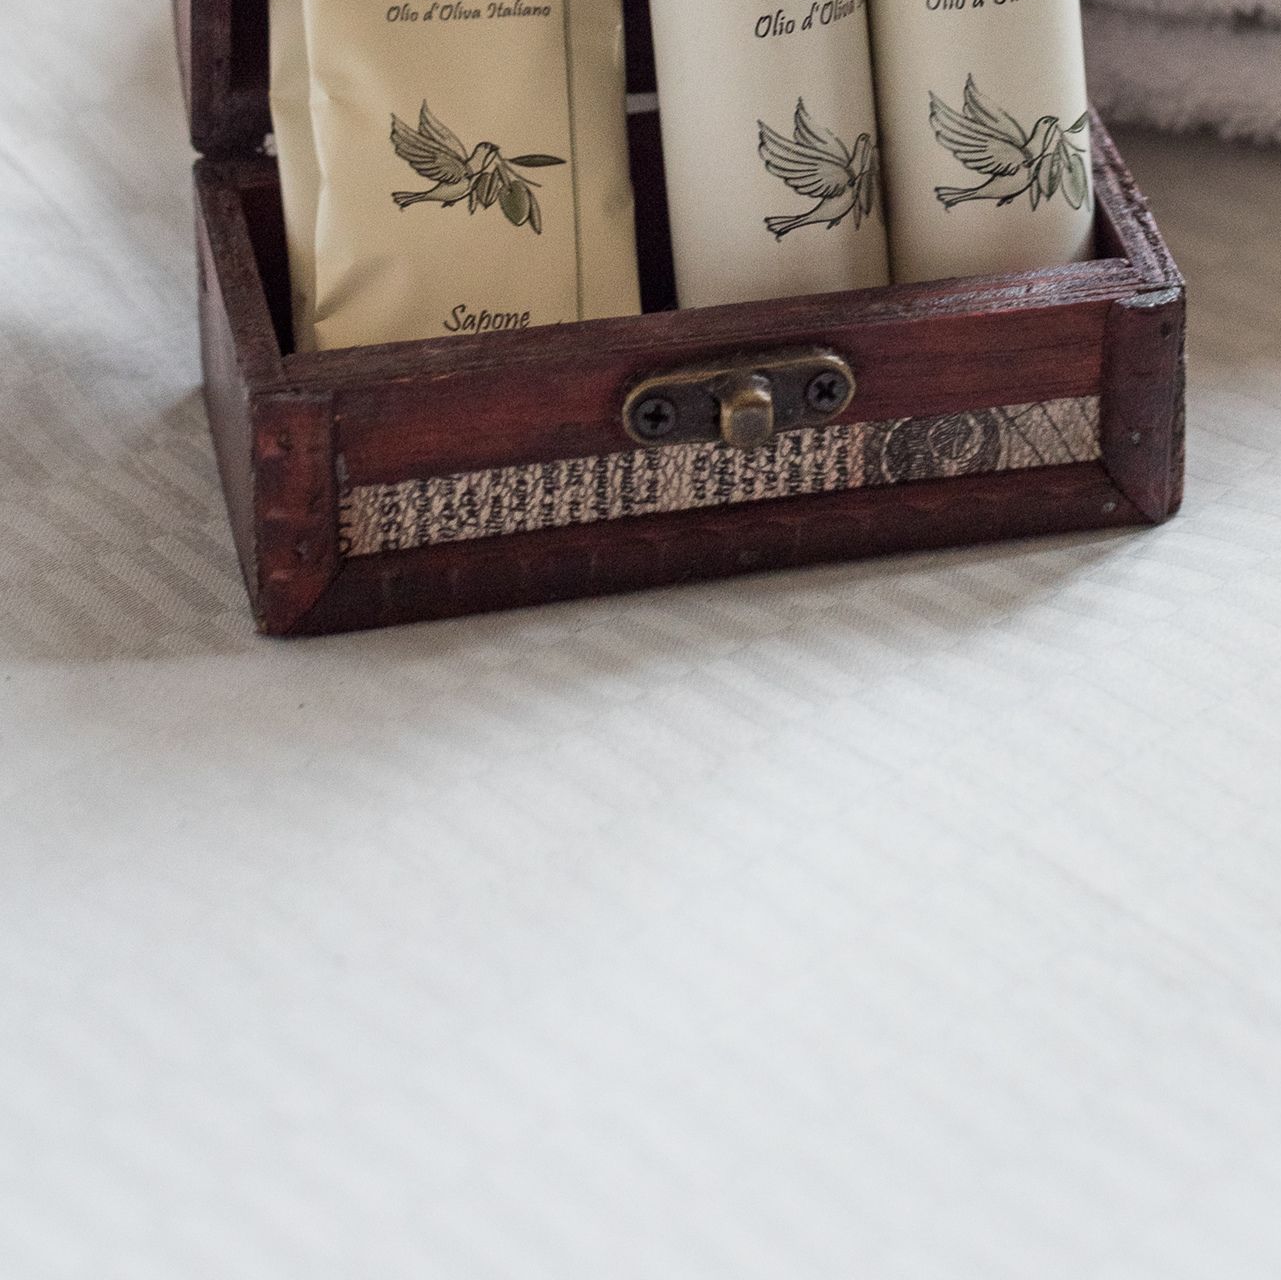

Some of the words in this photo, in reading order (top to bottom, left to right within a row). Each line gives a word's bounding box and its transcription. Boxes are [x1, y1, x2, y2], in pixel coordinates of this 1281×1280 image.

[386, 3, 420, 23] Olio
[422, 1, 482, 22] d'Oliva
[754, 8, 796, 39] Olio
[443, 303, 531, 335] Sapone
